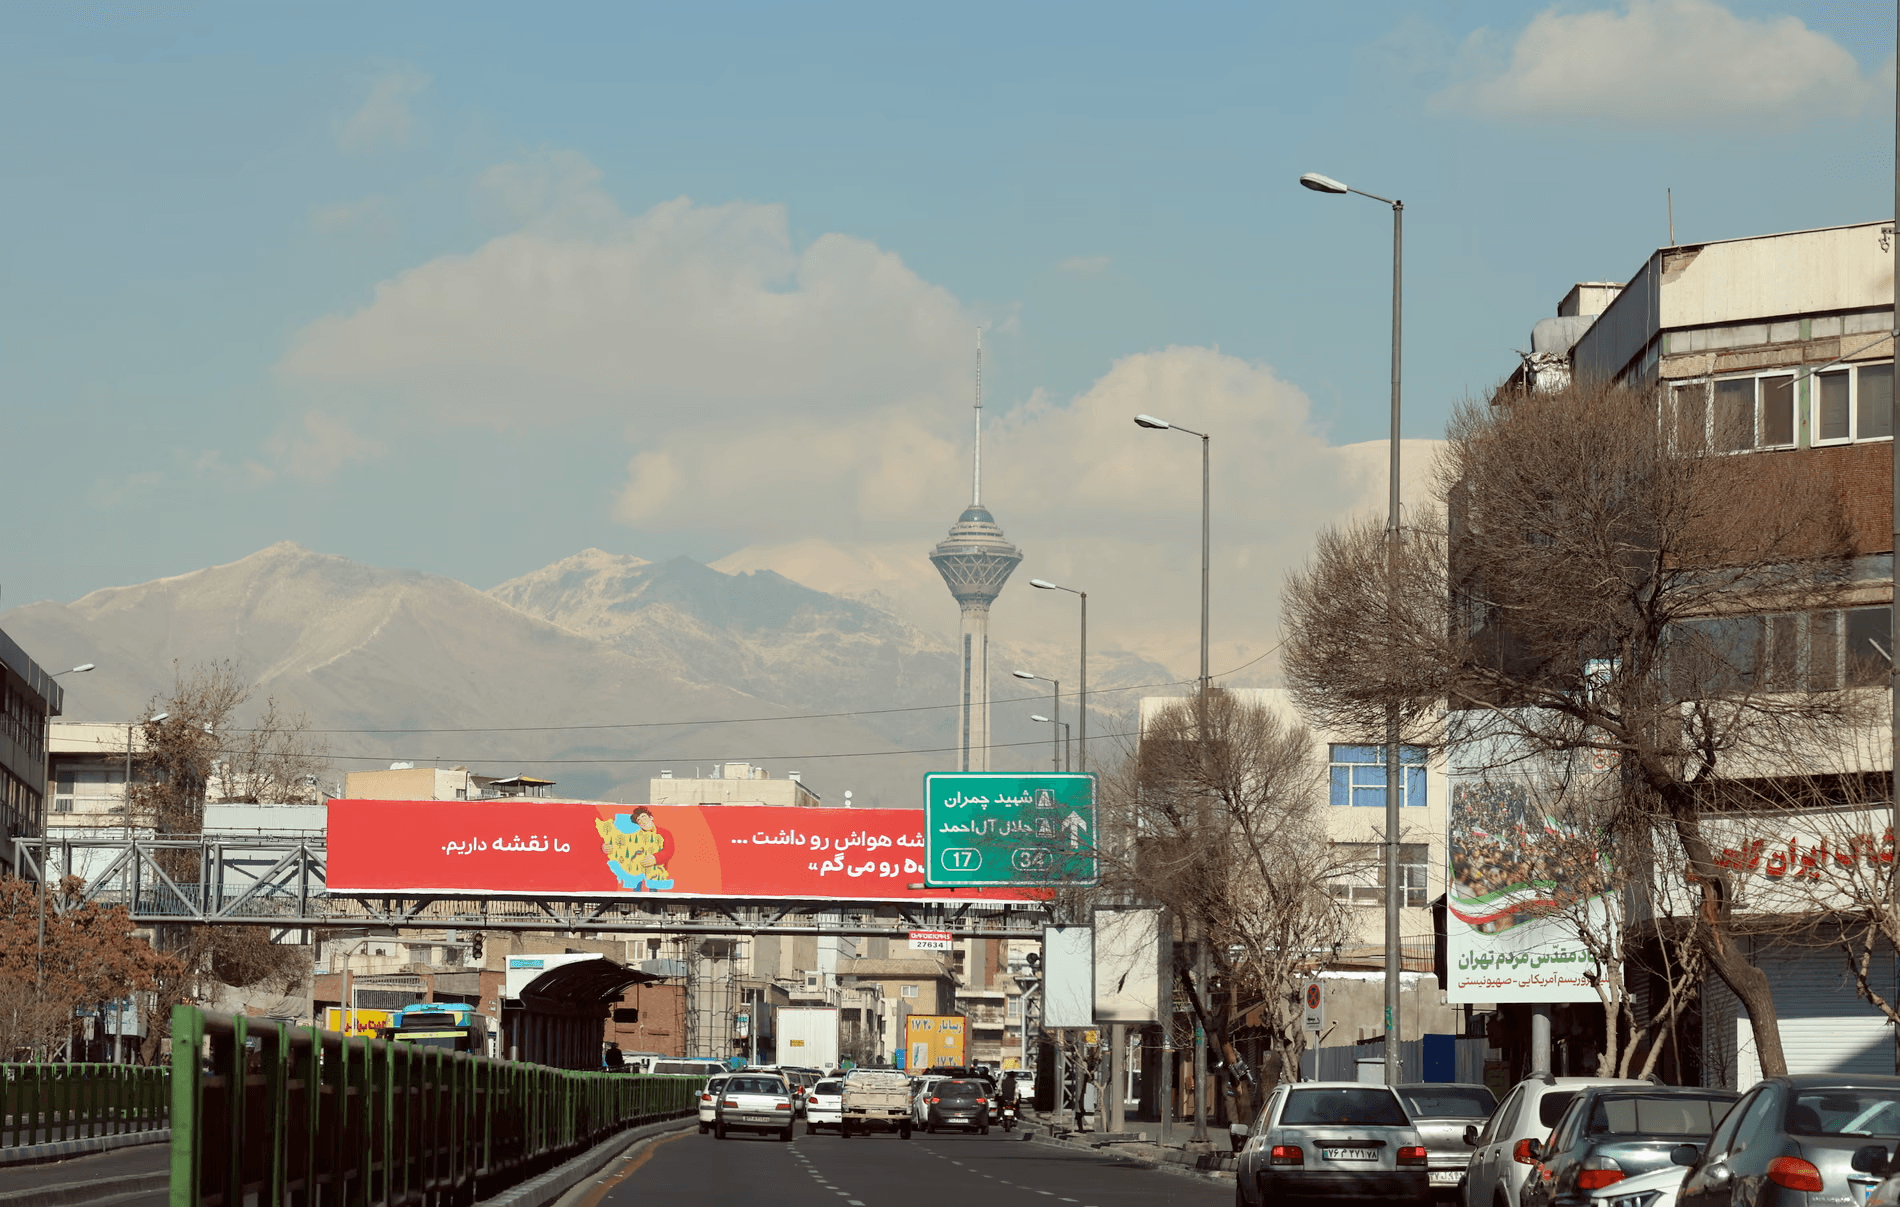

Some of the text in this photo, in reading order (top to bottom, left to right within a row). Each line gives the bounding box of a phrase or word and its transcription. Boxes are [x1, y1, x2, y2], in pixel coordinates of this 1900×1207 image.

[944, 789, 1033, 810] شهید چمران
[441, 834, 571, 855] ما نقشه داریم.
[752, 829, 806, 845] داشت
[810, 834, 830, 850] رو
[834, 830, 892, 851] هواش
[952, 851, 973, 867] 17
[1019, 851, 1045, 867] 34
[879, 863, 900, 877] رو
[916, 941, 944, 949] 27634
[1458, 949, 1494, 970] تهران
